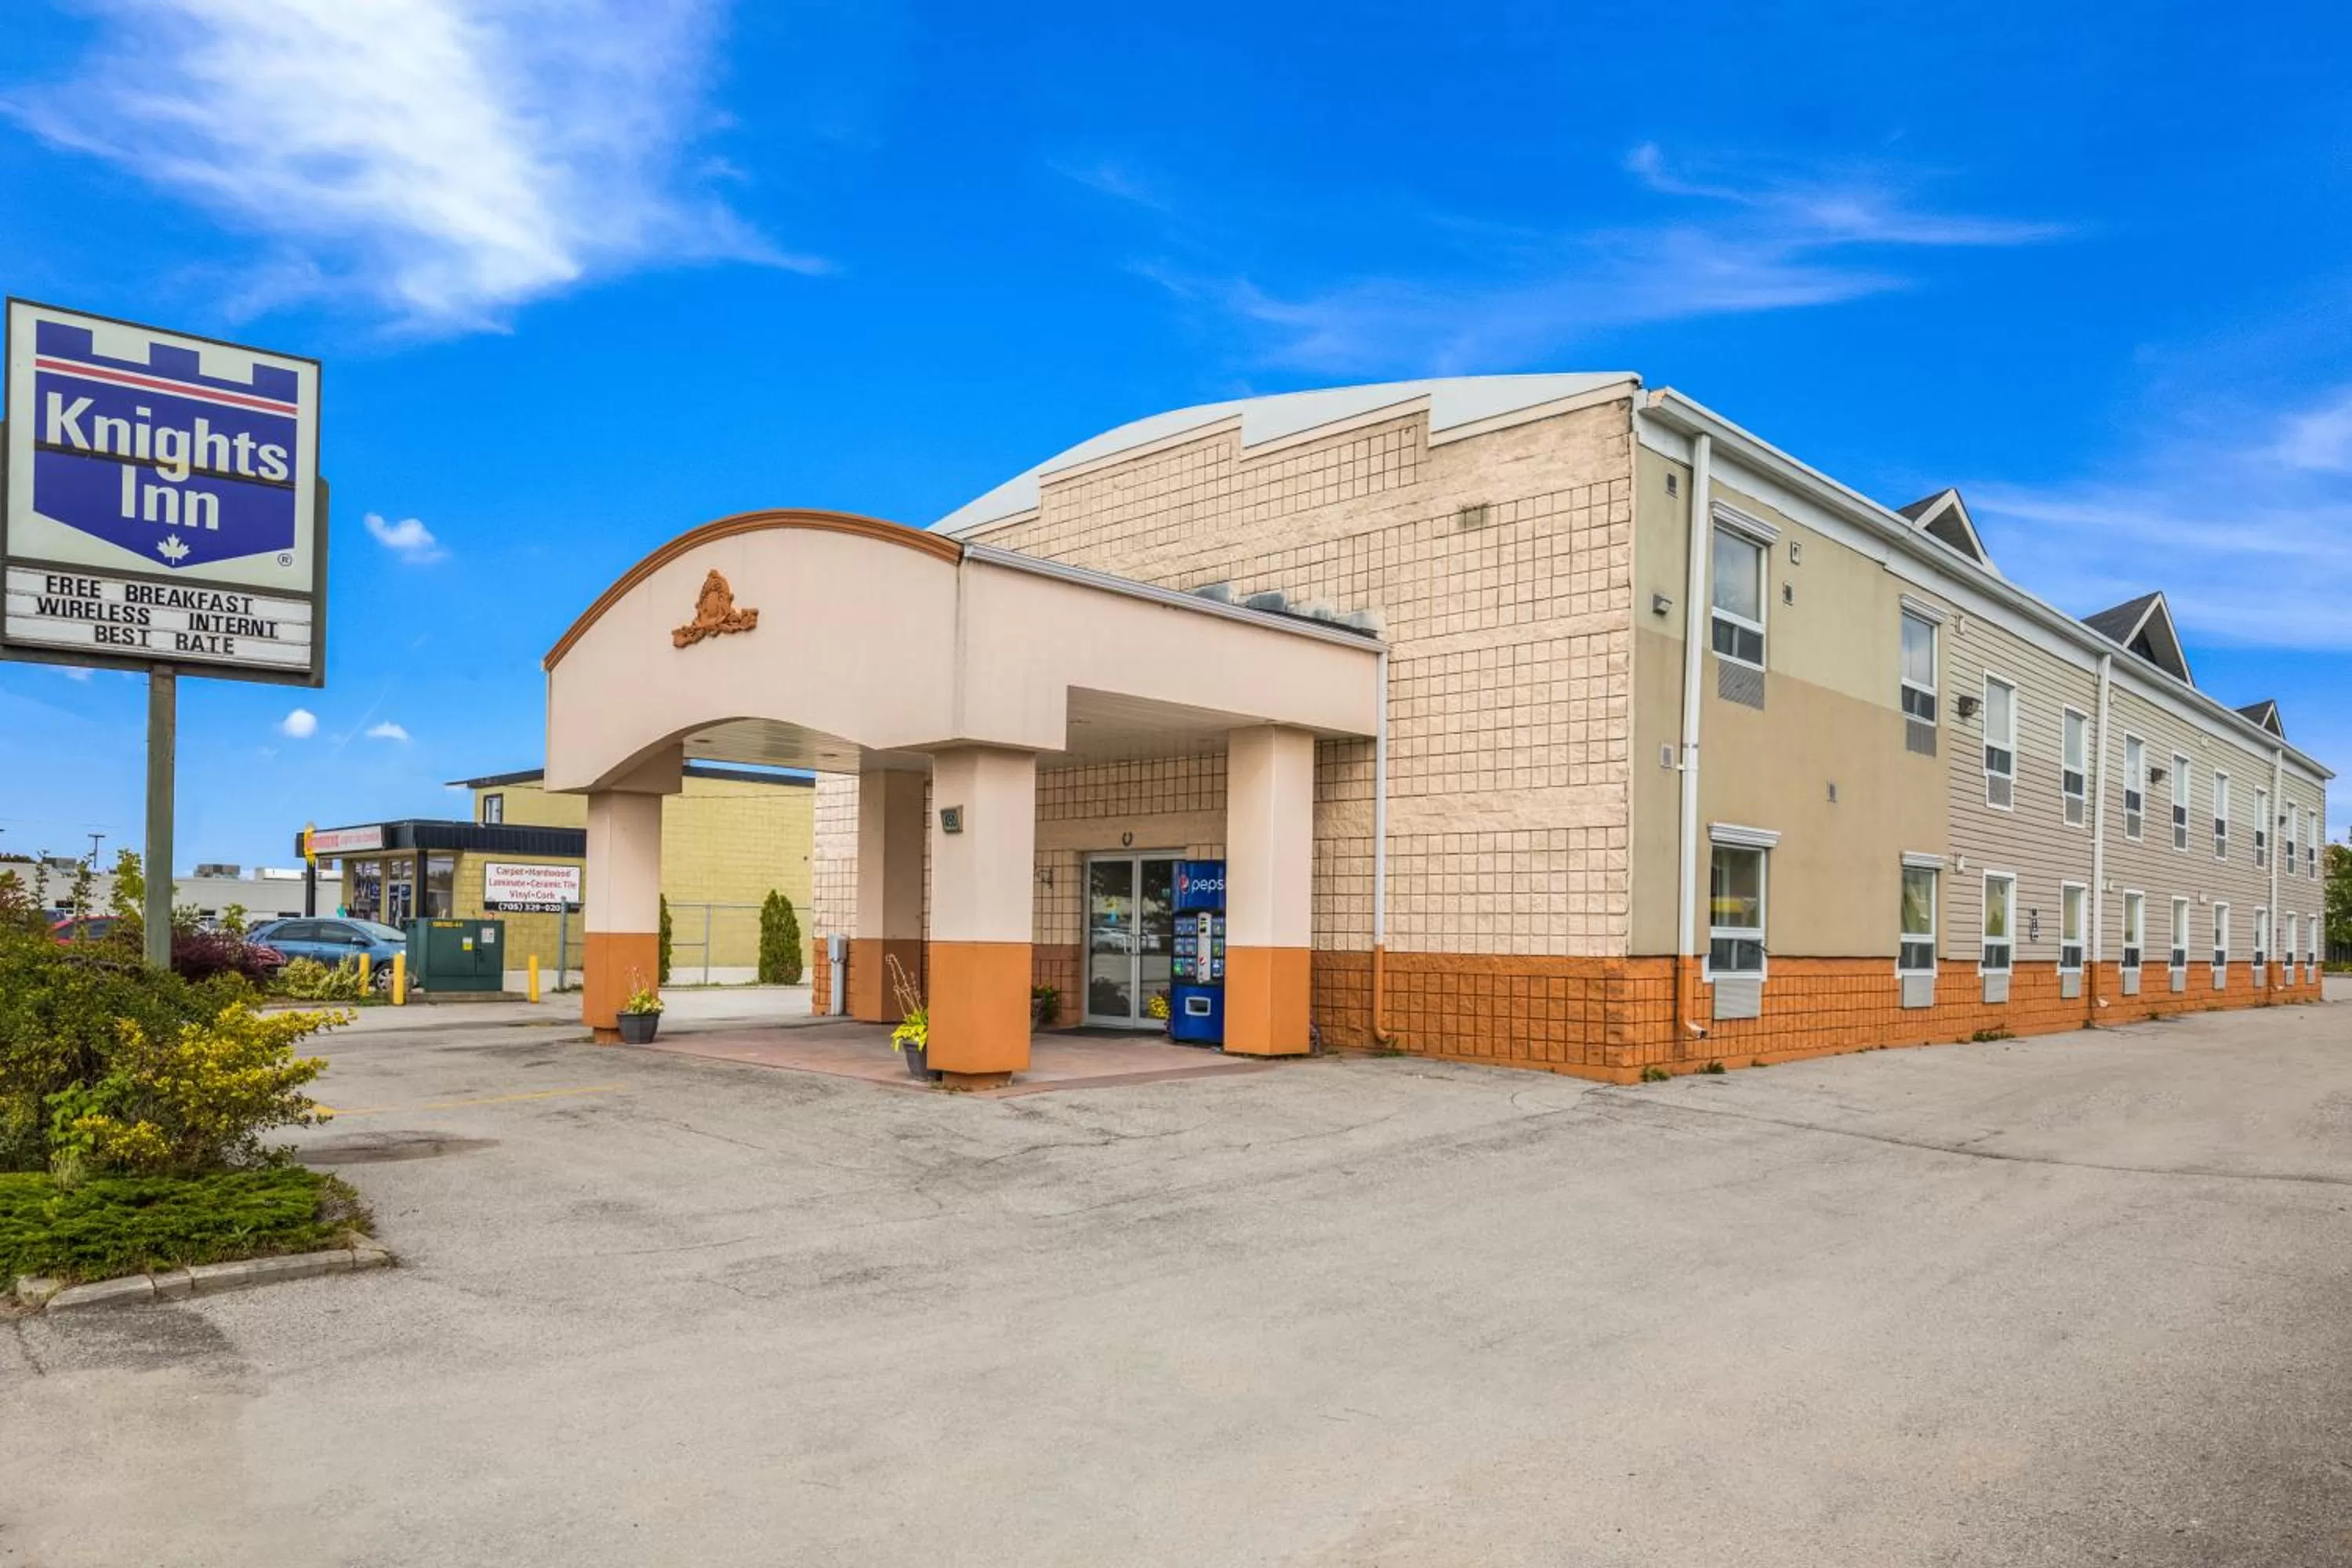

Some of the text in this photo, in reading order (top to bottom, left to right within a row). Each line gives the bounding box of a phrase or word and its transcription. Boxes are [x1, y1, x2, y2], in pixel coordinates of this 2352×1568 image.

[46, 391, 289, 482] Knights
[122, 464, 220, 531] Inn
[45, 574, 254, 615] FREE BREAKFAST
[36, 597, 279, 639] WIRELESS INTERNT
[94, 625, 234, 654] BEST RATE
[498, 902, 523, 912] (705)
[1191, 879, 1225, 894] peps
